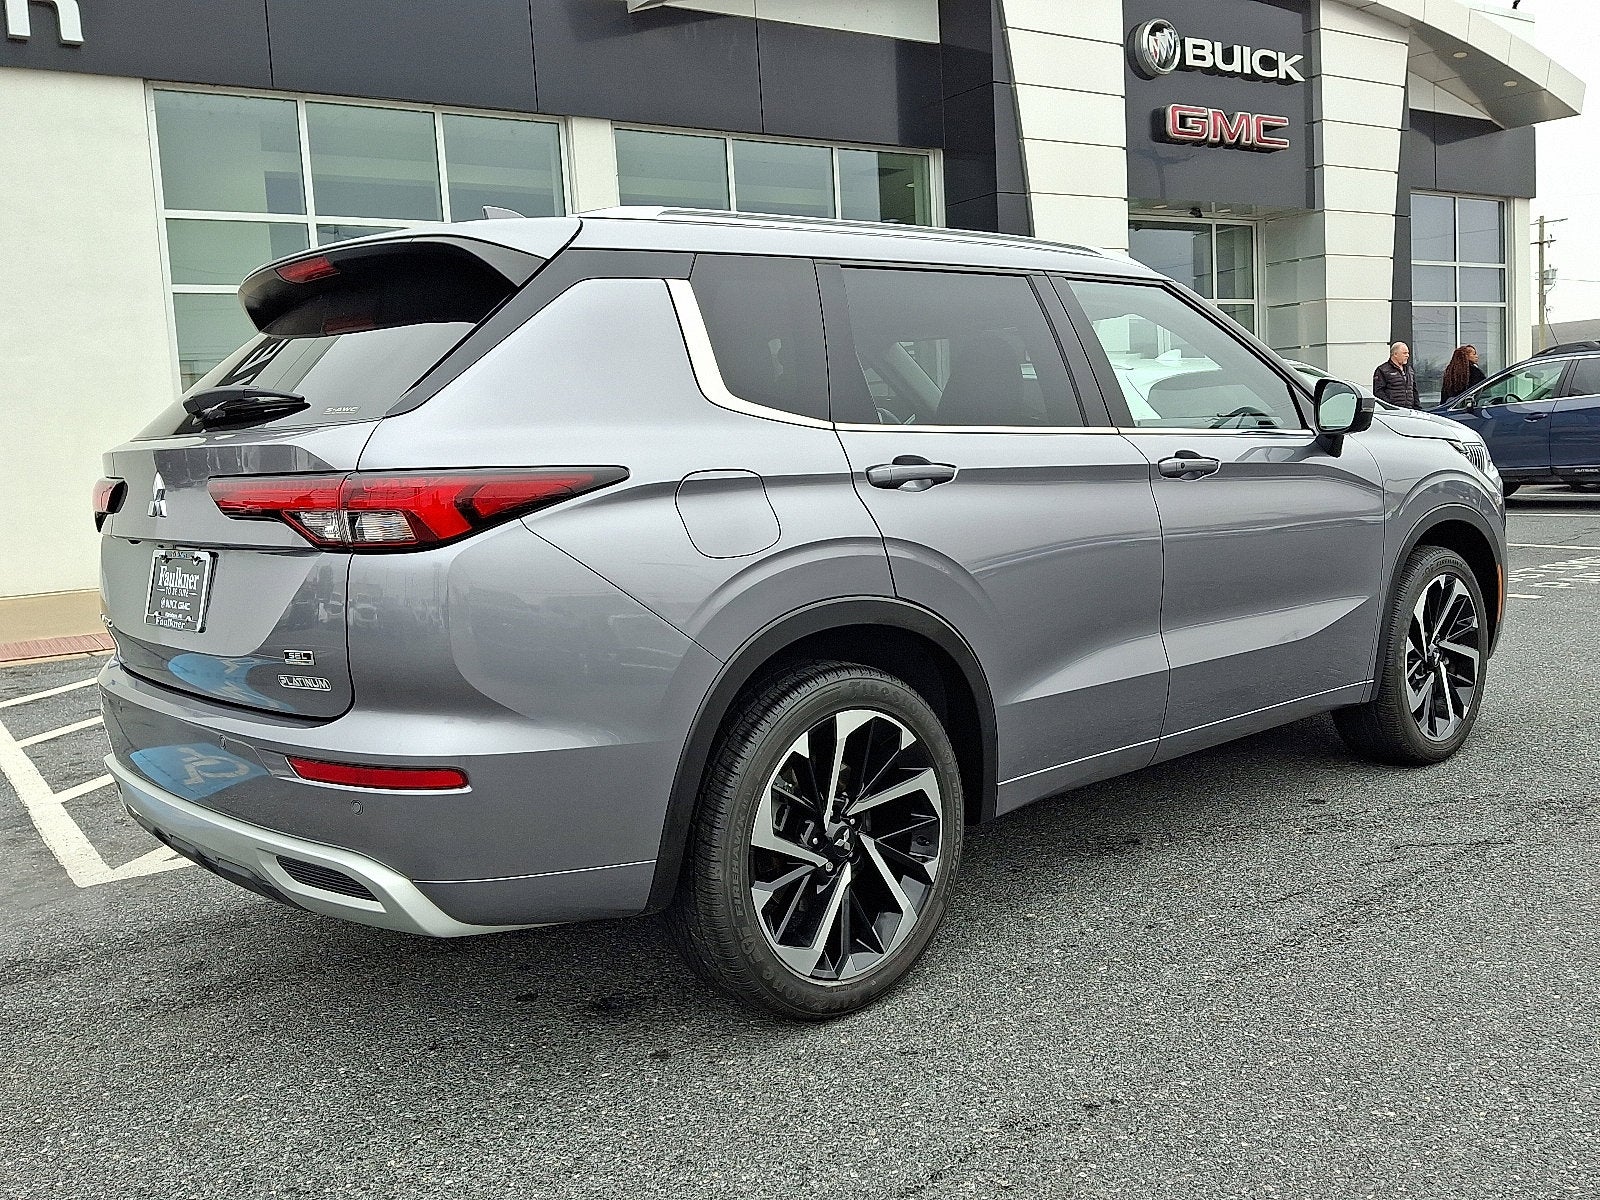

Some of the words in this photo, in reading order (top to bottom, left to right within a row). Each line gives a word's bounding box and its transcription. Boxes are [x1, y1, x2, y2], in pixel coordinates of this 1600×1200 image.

[1184, 36, 1306, 82] BUICK
[1165, 103, 1290, 149] GMC
[157, 565, 200, 591] Faulkner
[155, 616, 186, 629] Faulkner
[279, 676, 330, 688] PLATINUM
